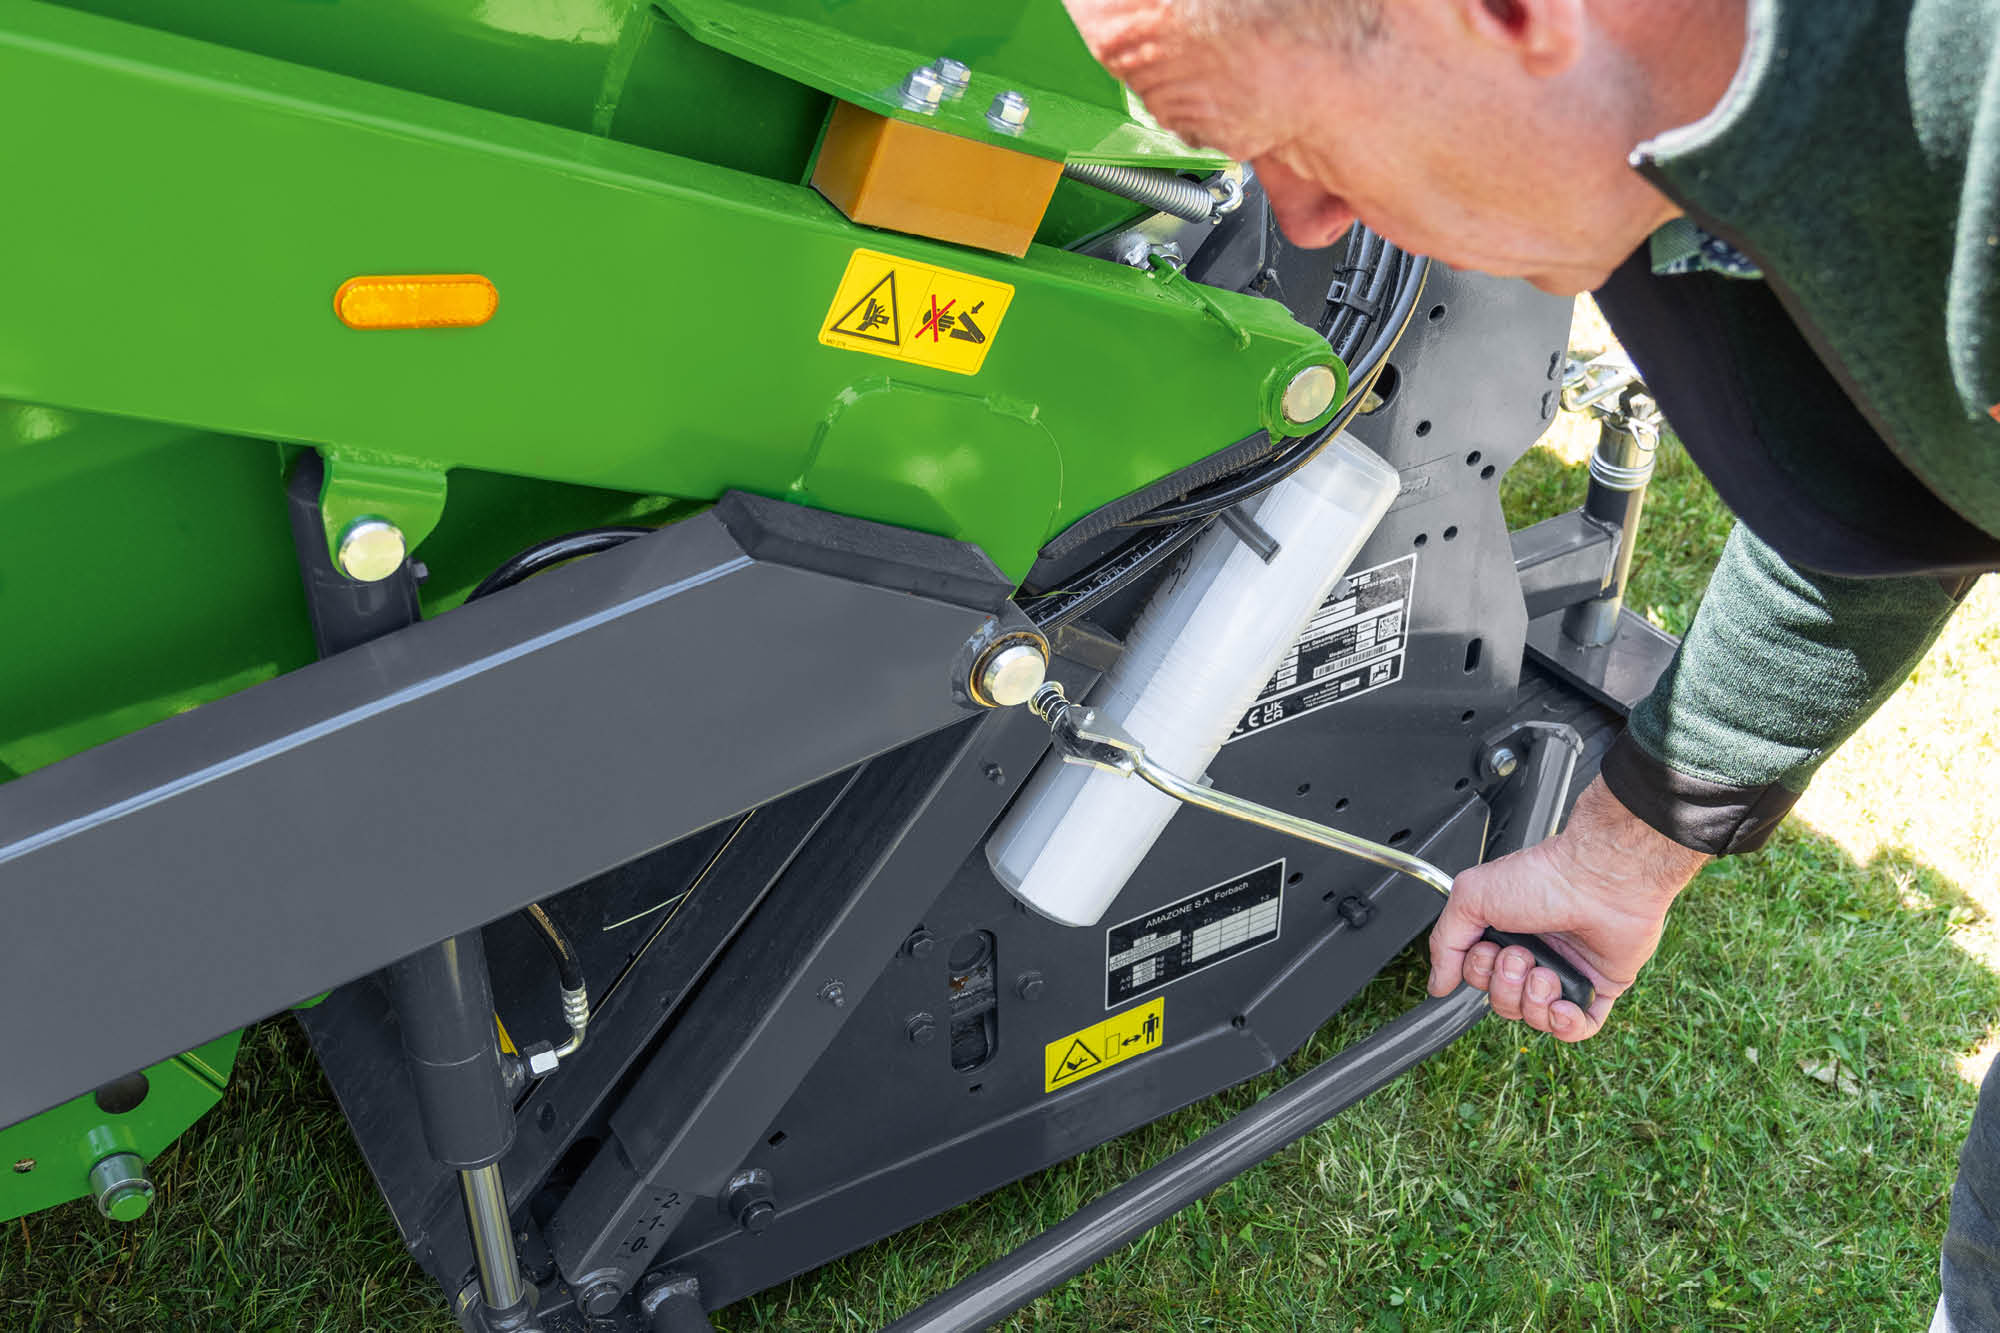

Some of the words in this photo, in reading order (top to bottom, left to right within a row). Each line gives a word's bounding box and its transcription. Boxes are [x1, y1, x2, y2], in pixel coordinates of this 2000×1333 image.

[1264, 701, 1284, 713] UK
[1264, 709, 1283, 723] CA
[1145, 903, 1193, 929] AMAZONE
[1214, 882, 1249, 901] Forbach
